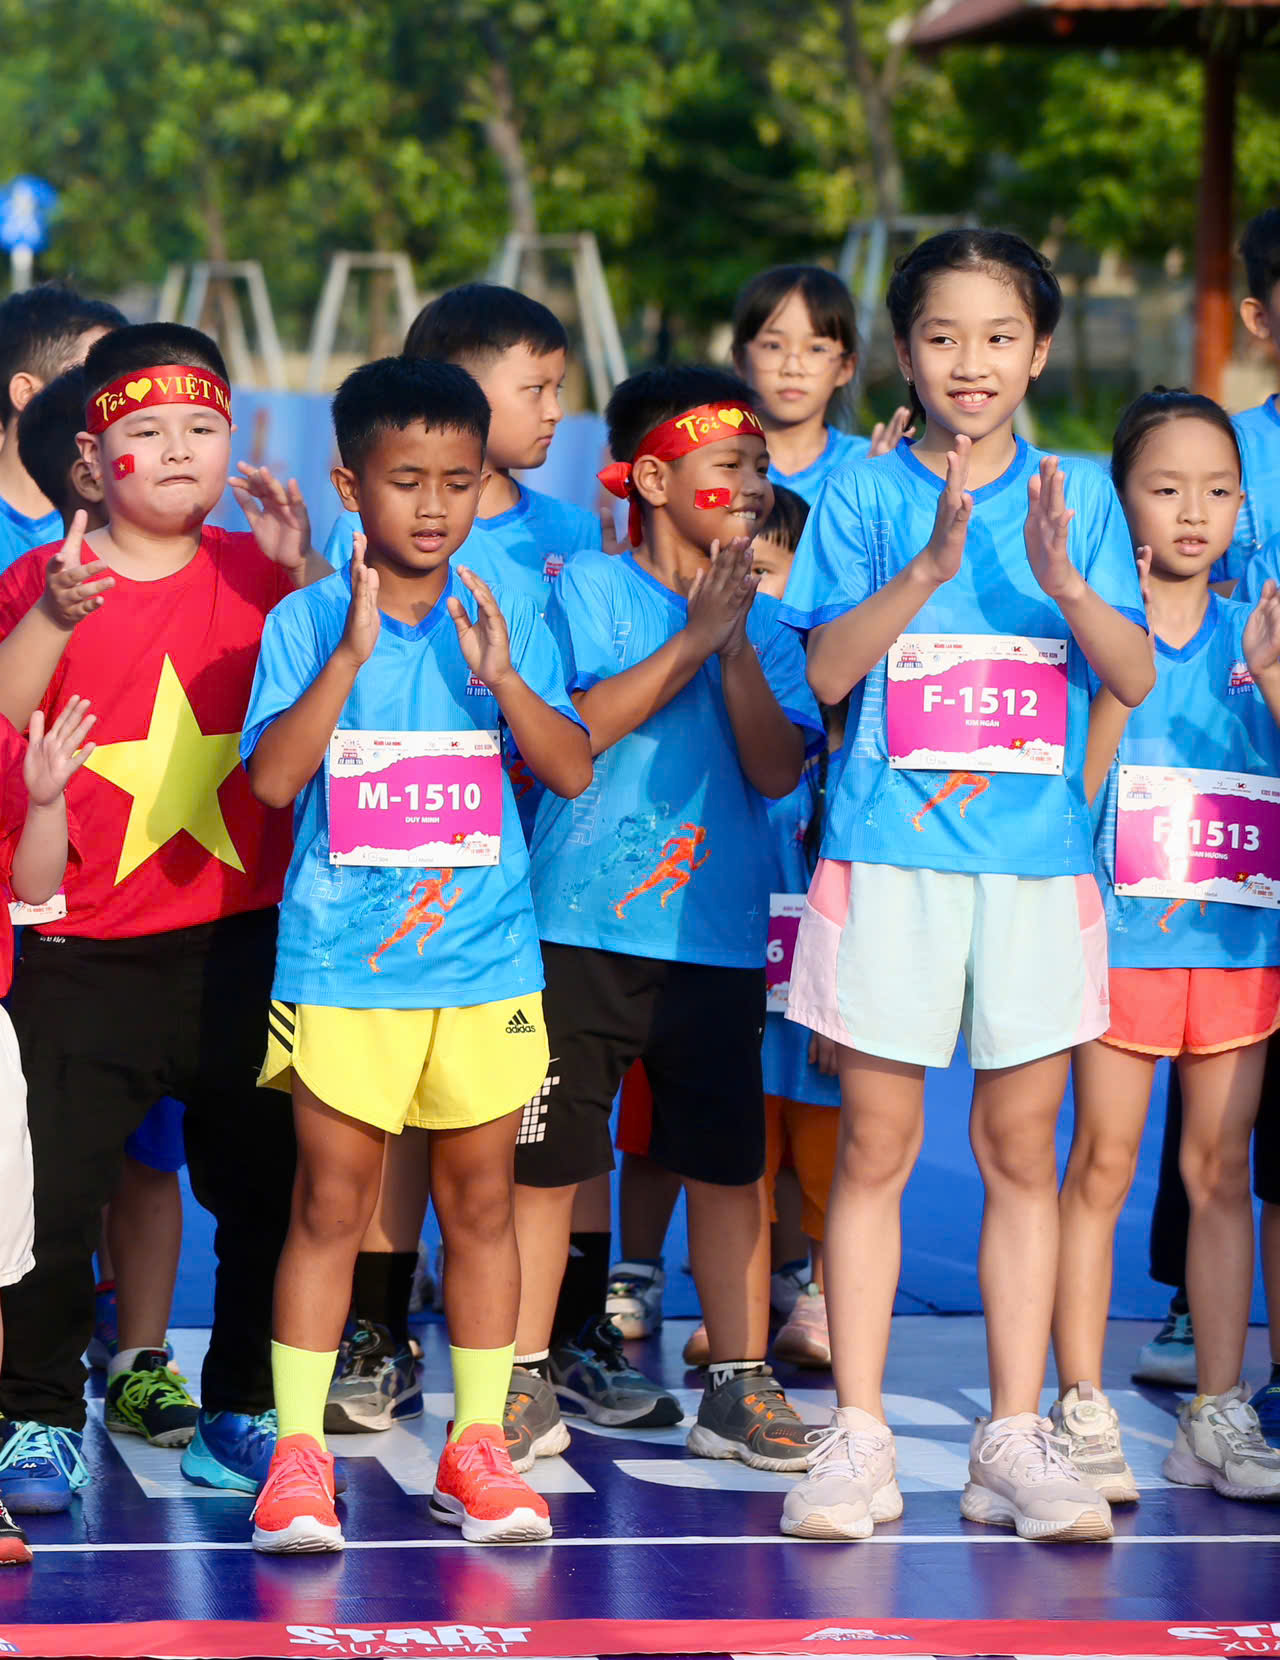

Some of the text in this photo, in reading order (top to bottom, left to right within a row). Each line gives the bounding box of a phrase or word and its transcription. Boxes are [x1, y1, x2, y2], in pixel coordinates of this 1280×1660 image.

[96, 373, 232, 421] Tôi VIỆT NA
[675, 415, 721, 443] Tôi
[923, 685, 1038, 717] F-1512
[358, 782, 481, 811] M-1510
[405, 816, 440, 824] DUY MINH
[505, 1023, 536, 1034] adidas
[286, 1625, 532, 1645] START
